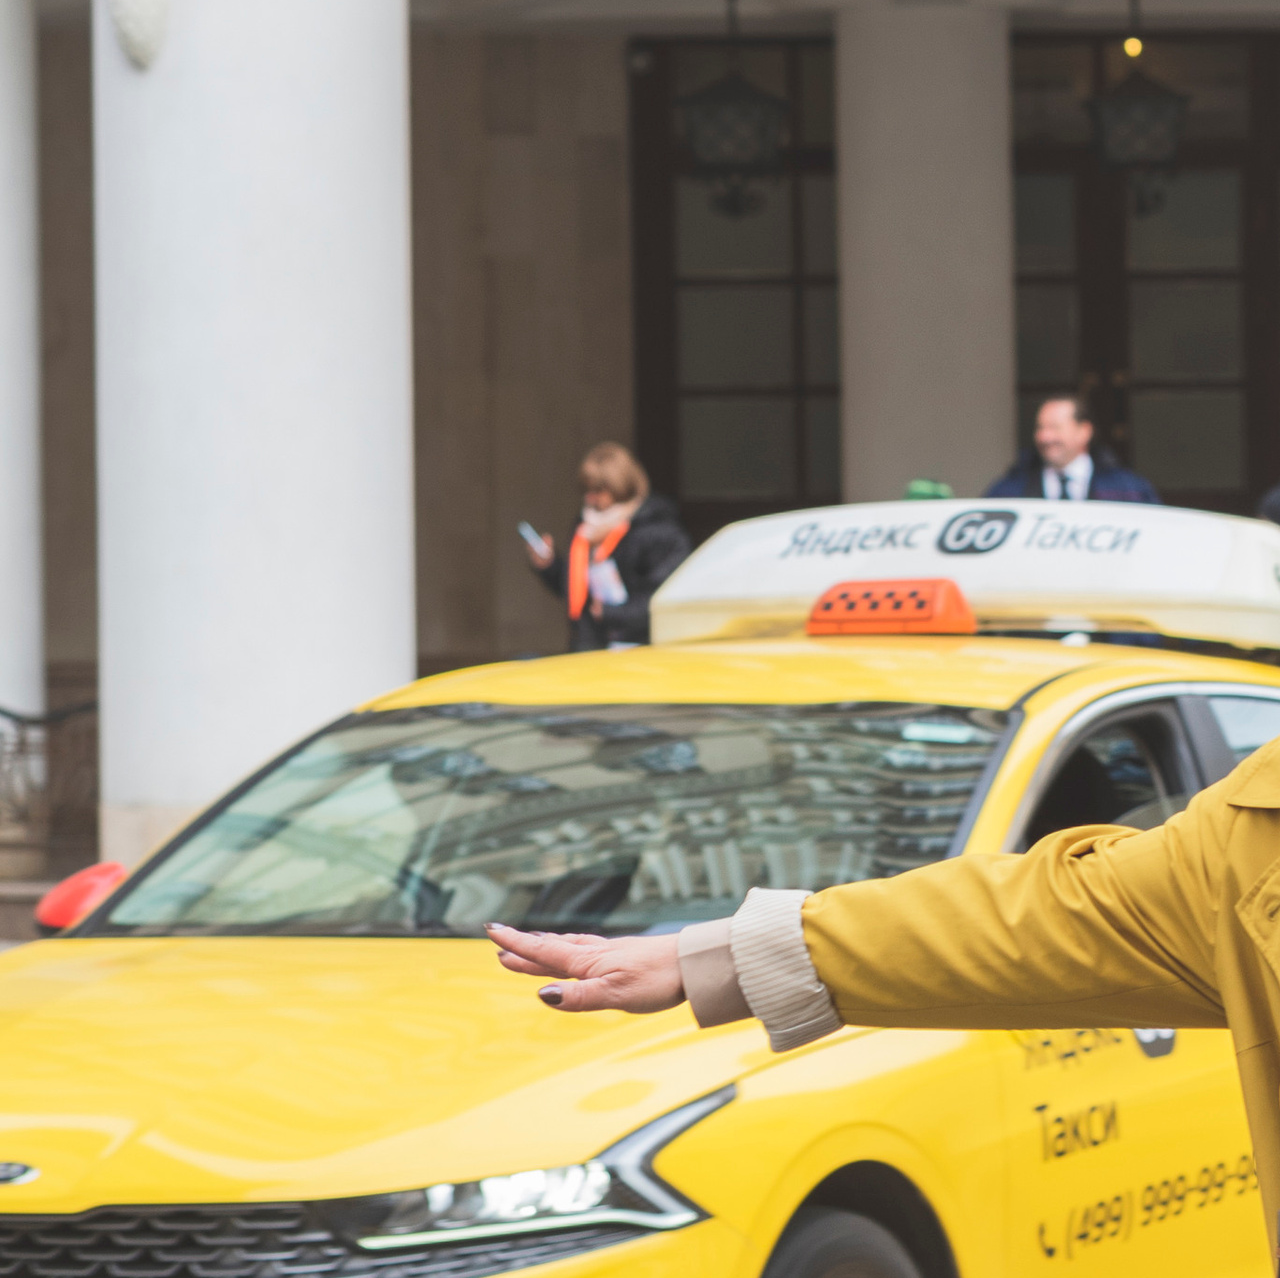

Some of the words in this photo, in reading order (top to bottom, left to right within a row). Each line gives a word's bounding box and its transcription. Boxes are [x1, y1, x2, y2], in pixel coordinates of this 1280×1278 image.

[780, 521, 929, 558] Яндекс
[941, 511, 1012, 553] Go
[1025, 513, 1141, 554] Такси
[1034, 1101, 1119, 1163] Такси
[1066, 1191, 1134, 1259] (499)
